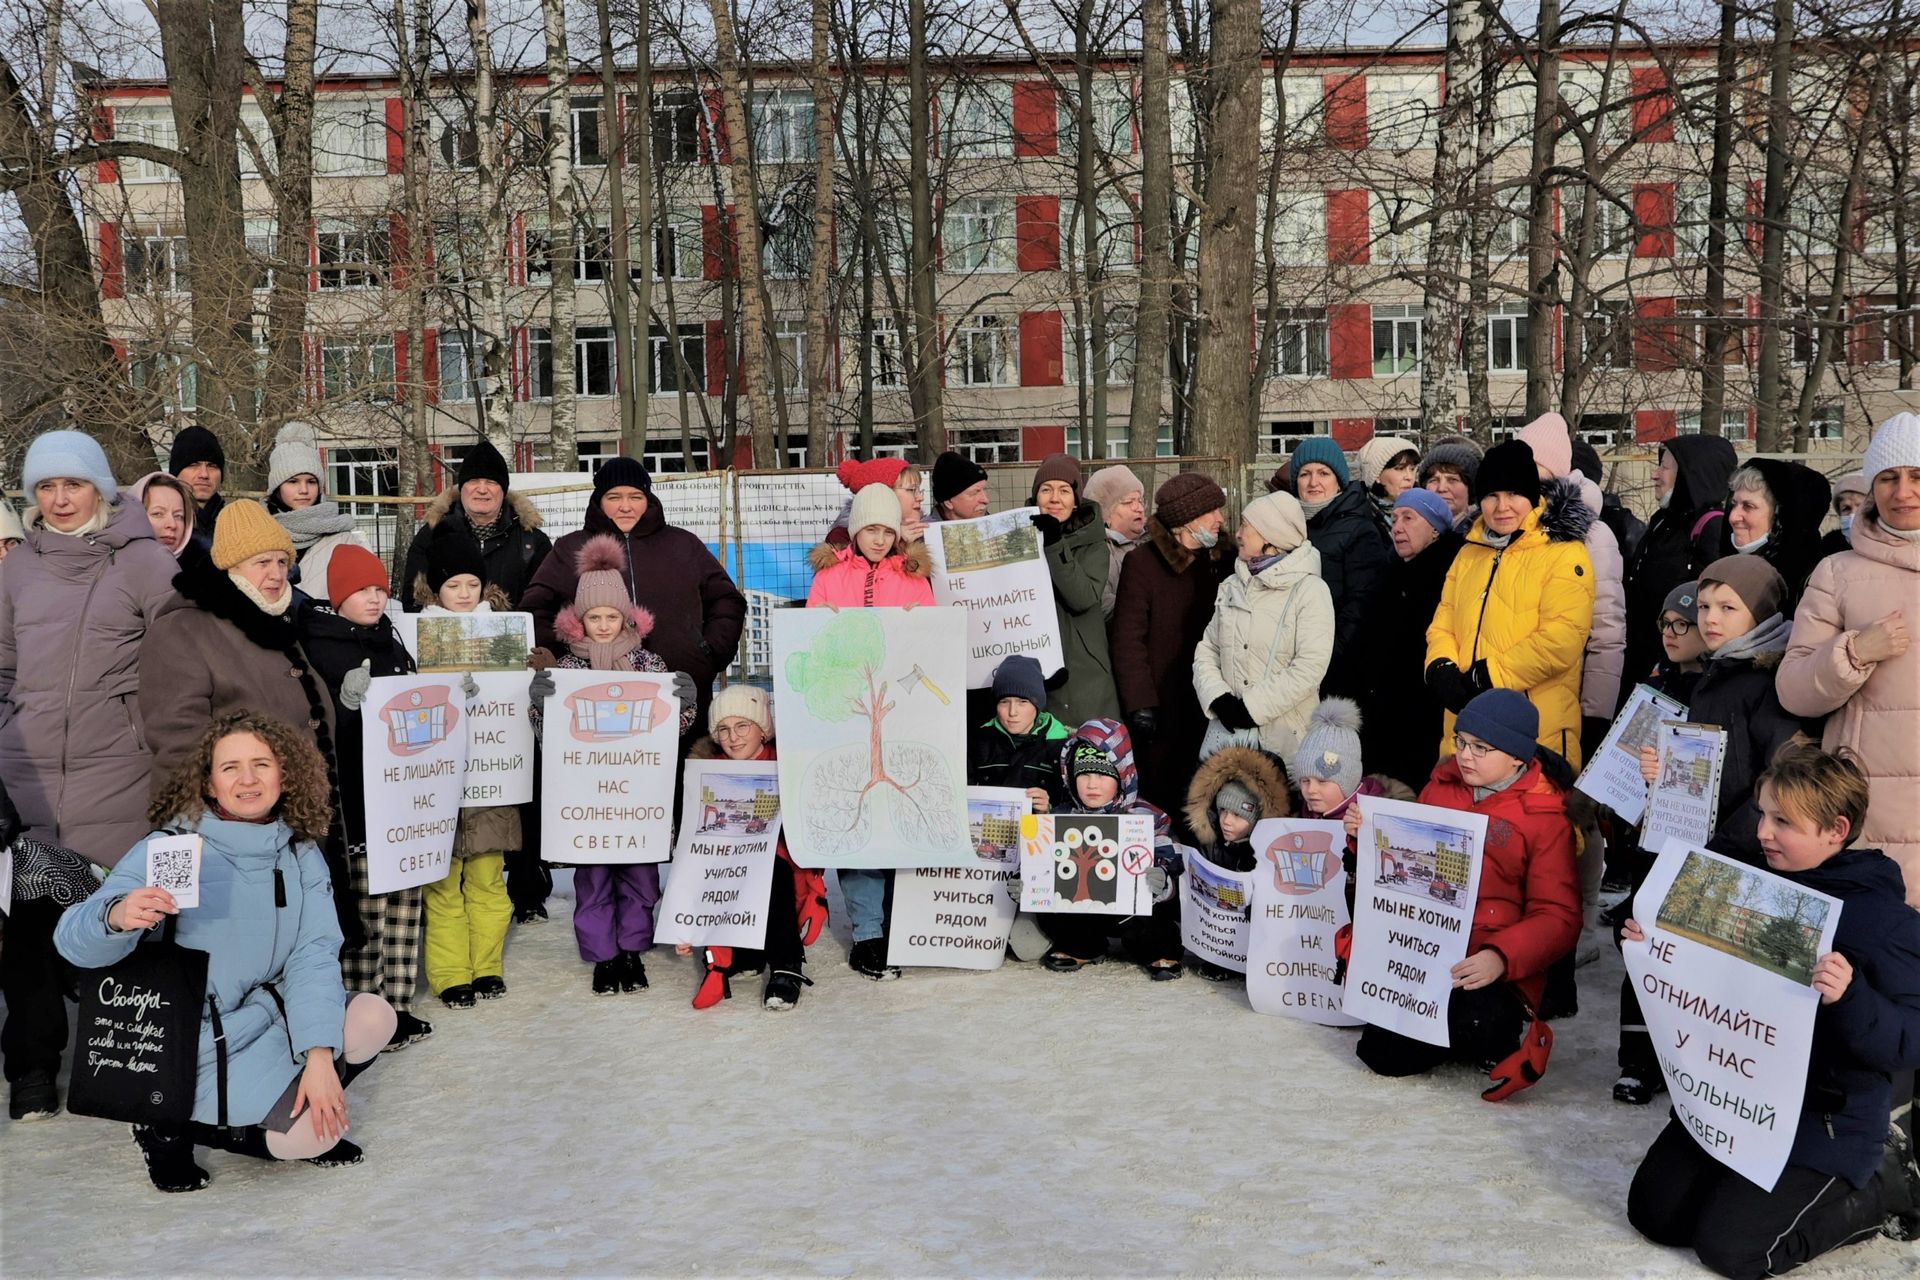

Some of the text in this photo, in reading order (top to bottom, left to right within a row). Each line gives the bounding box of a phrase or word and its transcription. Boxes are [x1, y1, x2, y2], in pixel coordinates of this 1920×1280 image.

[949, 577, 966, 591] НЕ
[983, 614, 1032, 633] У НАС
[972, 633, 1051, 659] ШКОЛЬНЫЙ
[465, 701, 515, 717] МАЙТЕ
[474, 730, 506, 745] НАС
[464, 754, 523, 773] ЛЬНЫЙ
[563, 749, 661, 766] НЕ ЛИШАЙТЕ
[384, 758, 456, 782] НЕ ЛИШАЙТЕ
[460, 784, 502, 800] КВЕР!
[597, 780, 629, 794] НАС
[1603, 769, 1644, 800] ШКОЛЬНЫЙ
[413, 793, 435, 810] НАС
[1656, 797, 1669, 809] МЫ
[1682, 803, 1707, 818] ХОТИМ
[560, 806, 665, 821] СОЛНЕЧНОГО
[386, 817, 456, 843] СОЛНЕЧНОГО
[1651, 822, 1662, 832] СО
[690, 841, 768, 856] МЫ НЕ ХОТИМ
[704, 865, 748, 880] УЧИТЬСЯ
[915, 867, 1014, 882] МЫ НЕ ХОТИМ
[701, 889, 740, 905] РЯДОМ
[933, 890, 994, 905] УЧИТЬСЯ
[675, 910, 756, 927] СО СТРОЙКОЙ!
[935, 913, 987, 928] РЯДОМ
[1212, 911, 1251, 924] ХОТИМ
[1266, 904, 1336, 925] НЕ ЛИШАЙТЕ
[1373, 896, 1461, 934] МЫ НЕ ХОТИМ
[1199, 915, 1237, 935] УЧИТЬСЯ
[908, 935, 1005, 950] СО СТРОЙКОЙ!
[1190, 934, 1201, 946] СО
[1202, 930, 1235, 947] РЯДОМ
[1388, 930, 1440, 958] УЧИТЬСЯ
[1648, 936, 1676, 964] НЕ
[1266, 962, 1336, 982] СОЛНЕЧНО
[1387, 959, 1427, 985] РЯДОМ
[1361, 981, 1439, 1019] СО СТРОЙКОЙ!
[1643, 974, 1777, 1047] ОТНИМАЙТЕ
[113, 1021, 125, 1030] не
[88, 1030, 115, 1048] слово
[1675, 1030, 1757, 1079] У НАС
[1659, 1052, 1777, 1131] ШКОЛЬНЫЙ
[1679, 1103, 1734, 1155] СКВЕР!
